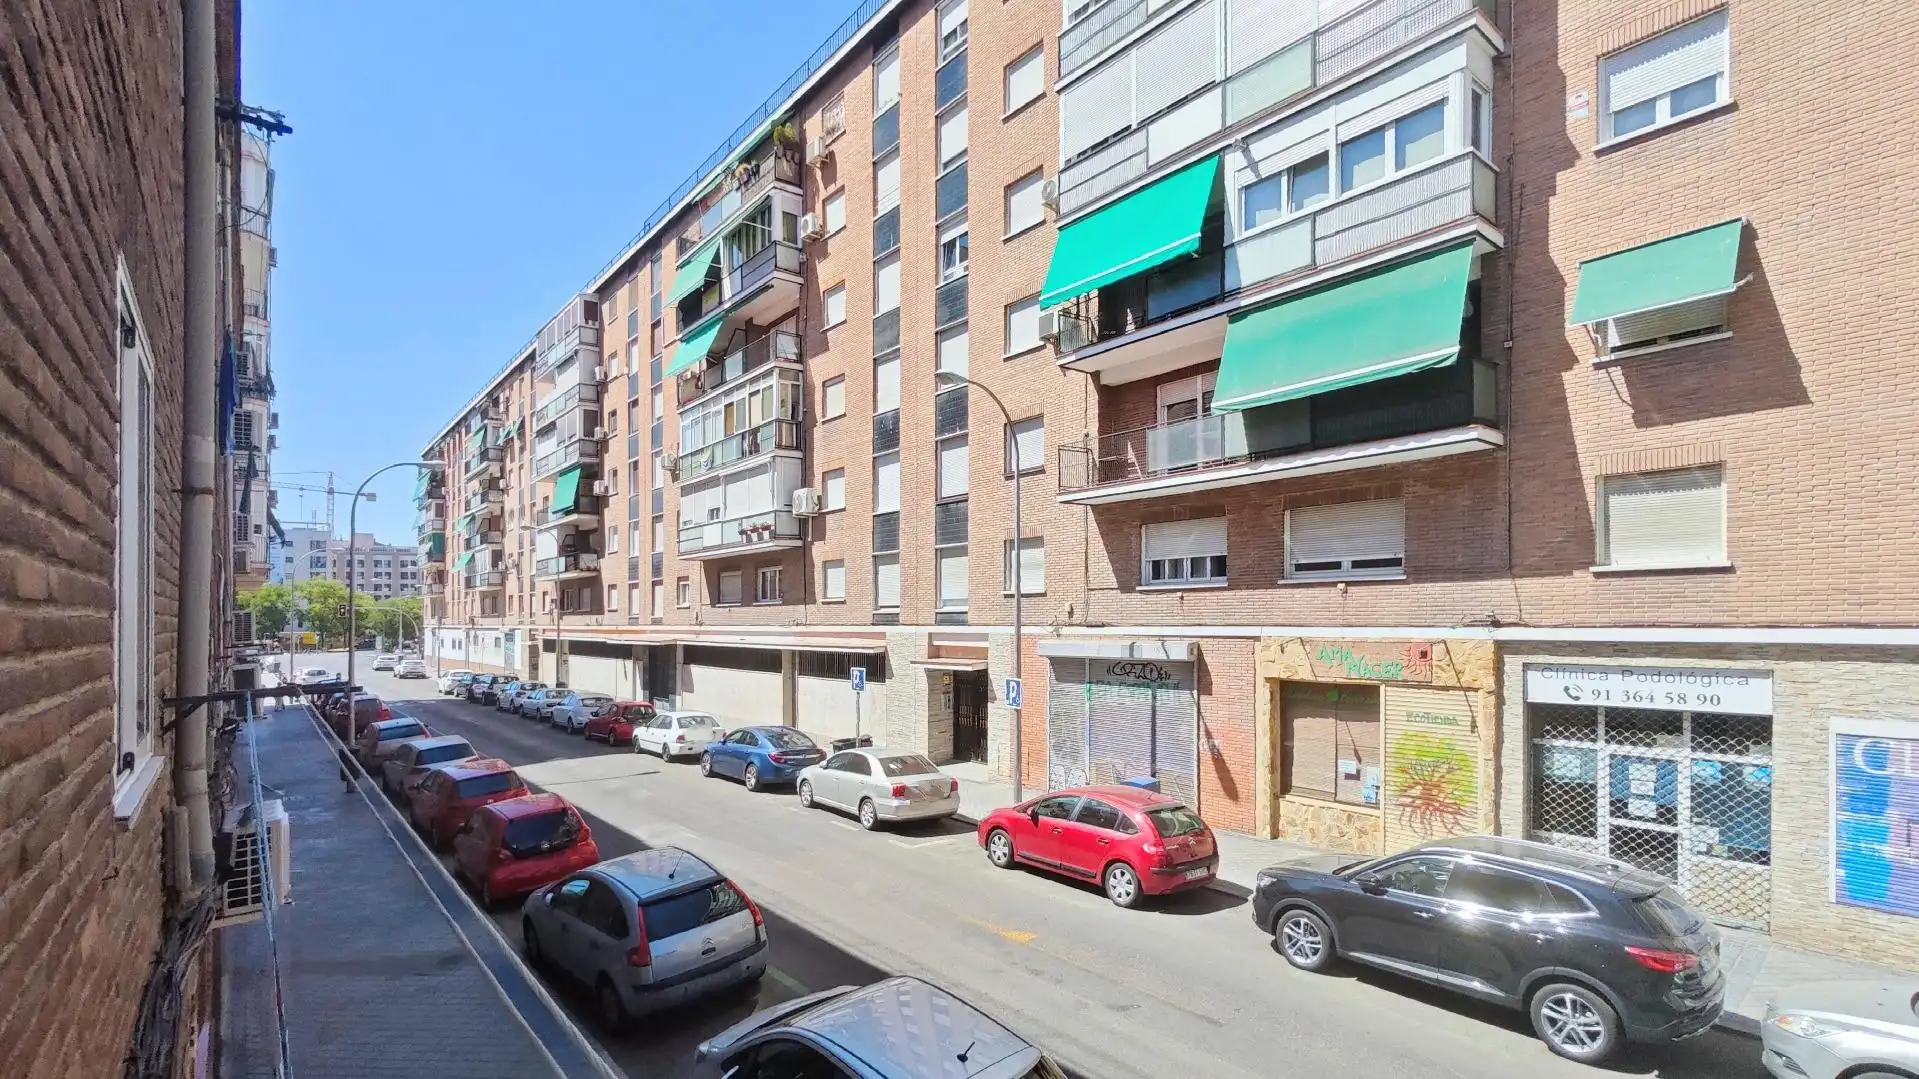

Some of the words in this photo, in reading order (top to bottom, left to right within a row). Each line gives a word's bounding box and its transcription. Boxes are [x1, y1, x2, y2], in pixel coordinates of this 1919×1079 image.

[1541, 667, 1609, 681] Clínica
[1621, 669, 1749, 688] Podológica
[1009, 680, 1018, 704] P
[1591, 688, 1610, 701] 91
[1620, 690, 1655, 703] 364
[1664, 692, 1687, 705] 58
[1696, 693, 1721, 706] 90
